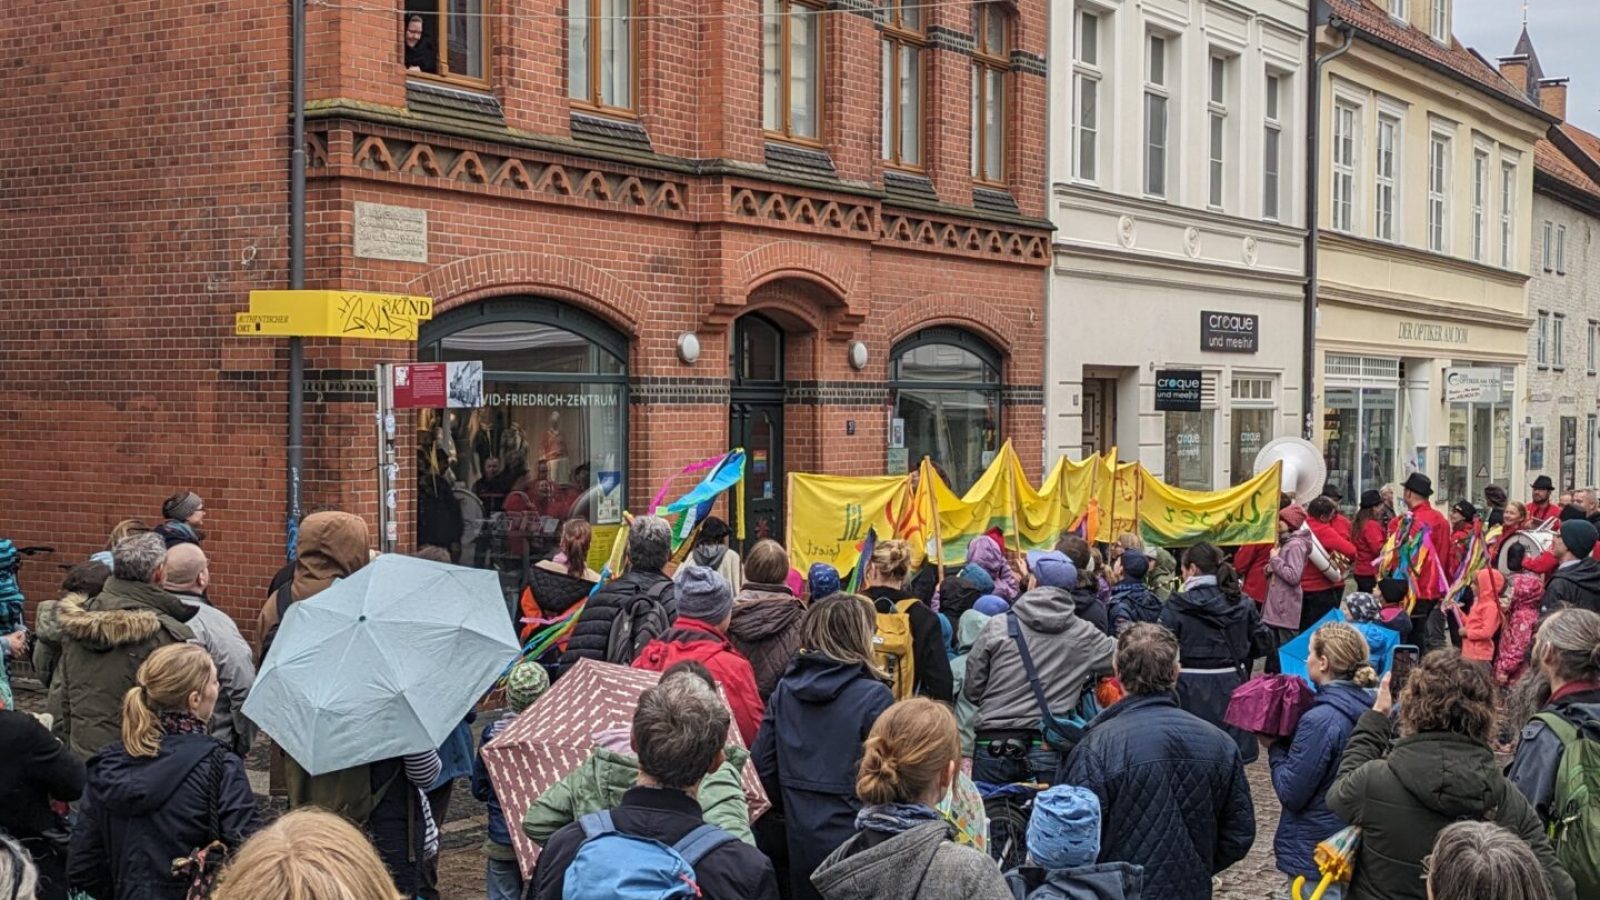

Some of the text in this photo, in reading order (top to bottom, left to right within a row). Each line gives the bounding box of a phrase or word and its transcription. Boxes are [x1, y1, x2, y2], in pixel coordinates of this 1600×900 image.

[237, 324, 251, 332] ORT
[1209, 314, 1253, 333] croque
[1398, 321, 1413, 340] DER
[1413, 322, 1442, 341] OPTIKER
[1208, 336, 1223, 347] und
[1157, 378, 1200, 390] croque
